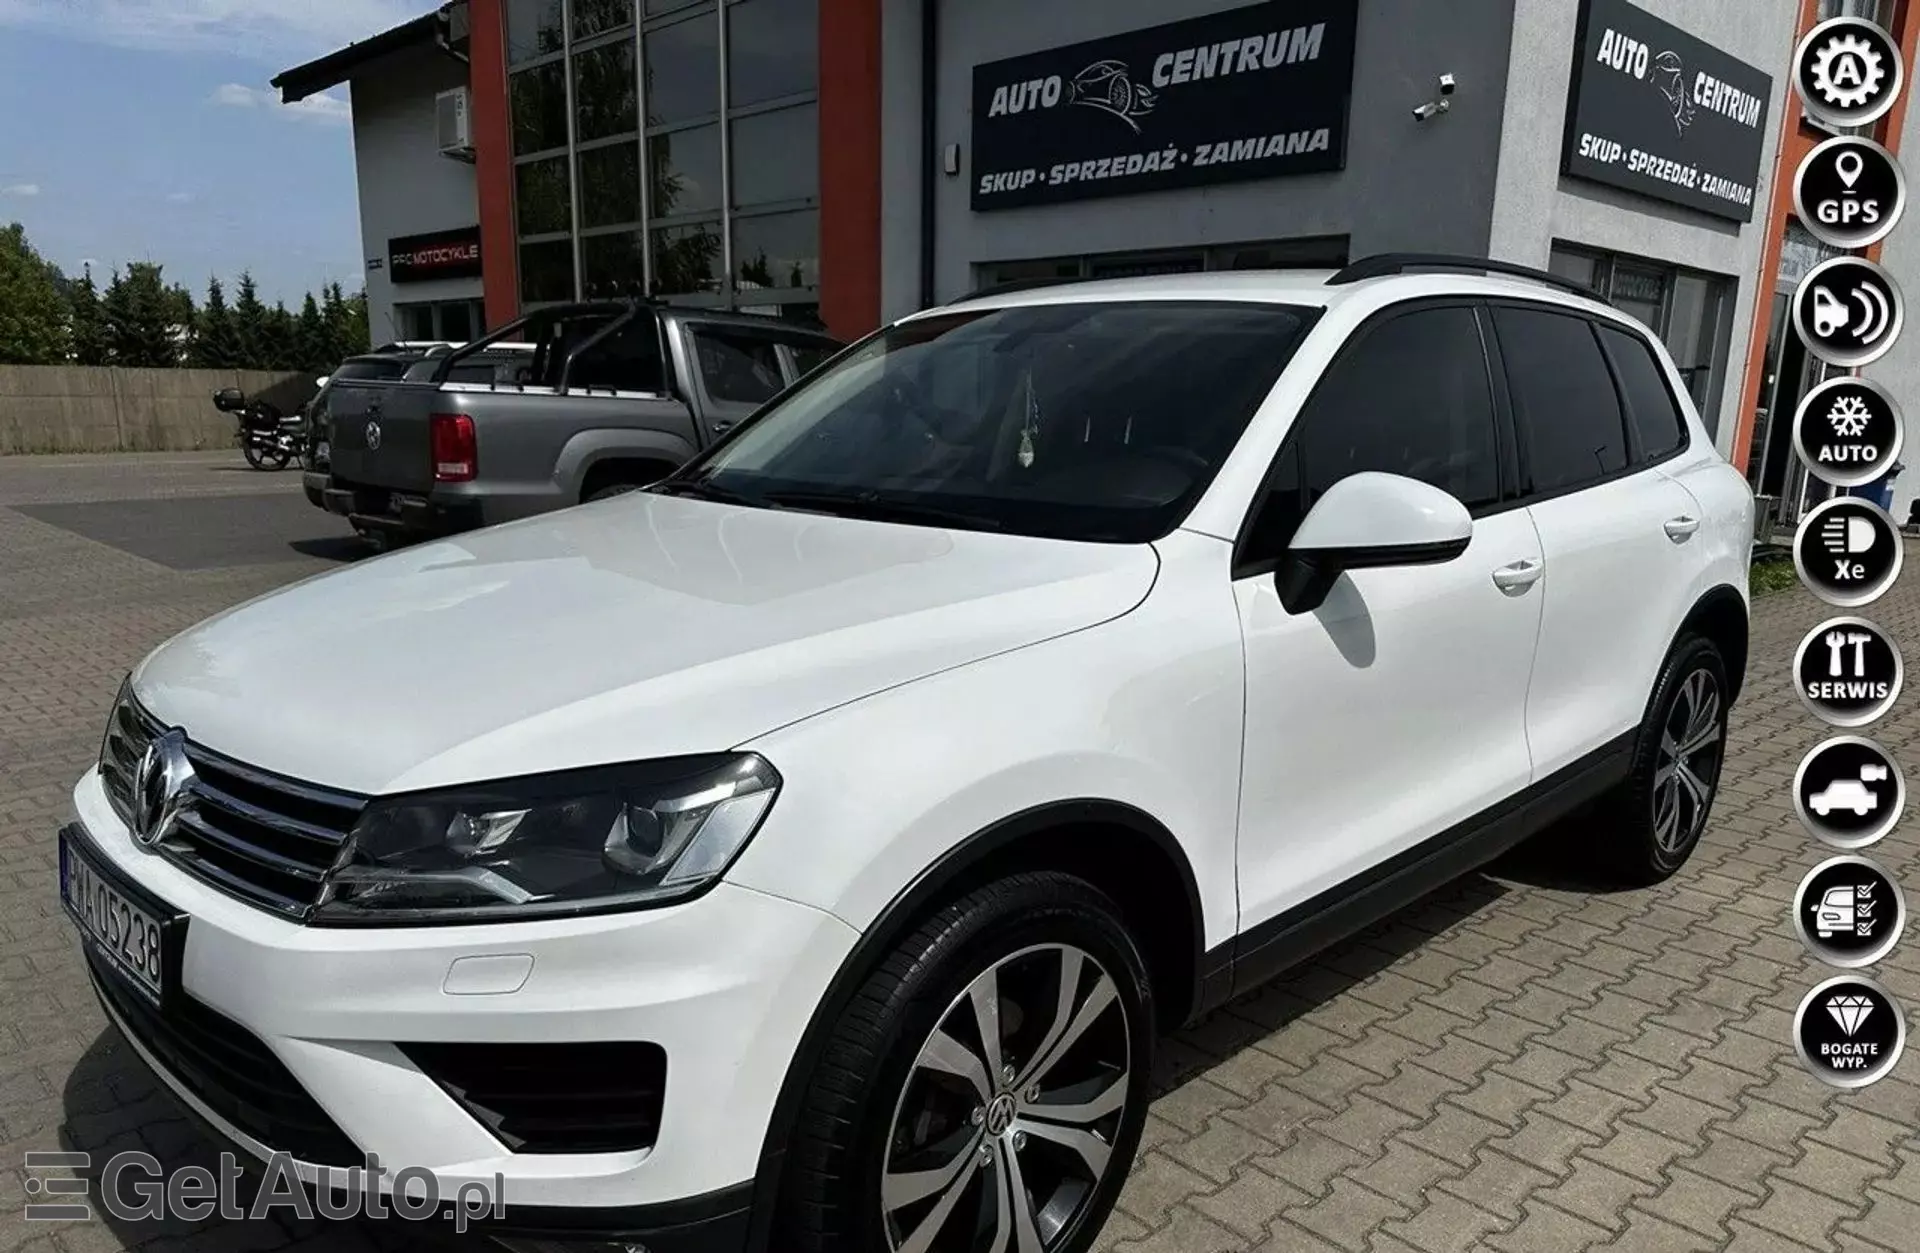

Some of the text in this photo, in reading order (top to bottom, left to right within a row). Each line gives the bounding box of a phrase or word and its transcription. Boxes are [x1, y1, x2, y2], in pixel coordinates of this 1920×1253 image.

[988, 23, 1326, 118] AUTO CENTRUM
[1596, 28, 1762, 128] AUTO CENTRUM
[979, 128, 1331, 195] SKUP SPRZEDAŻ ZAMIANA
[1579, 133, 1753, 207] SKUP SPRZEDAŻ ZAMIANA
[98, 881, 161, 983] 05238
